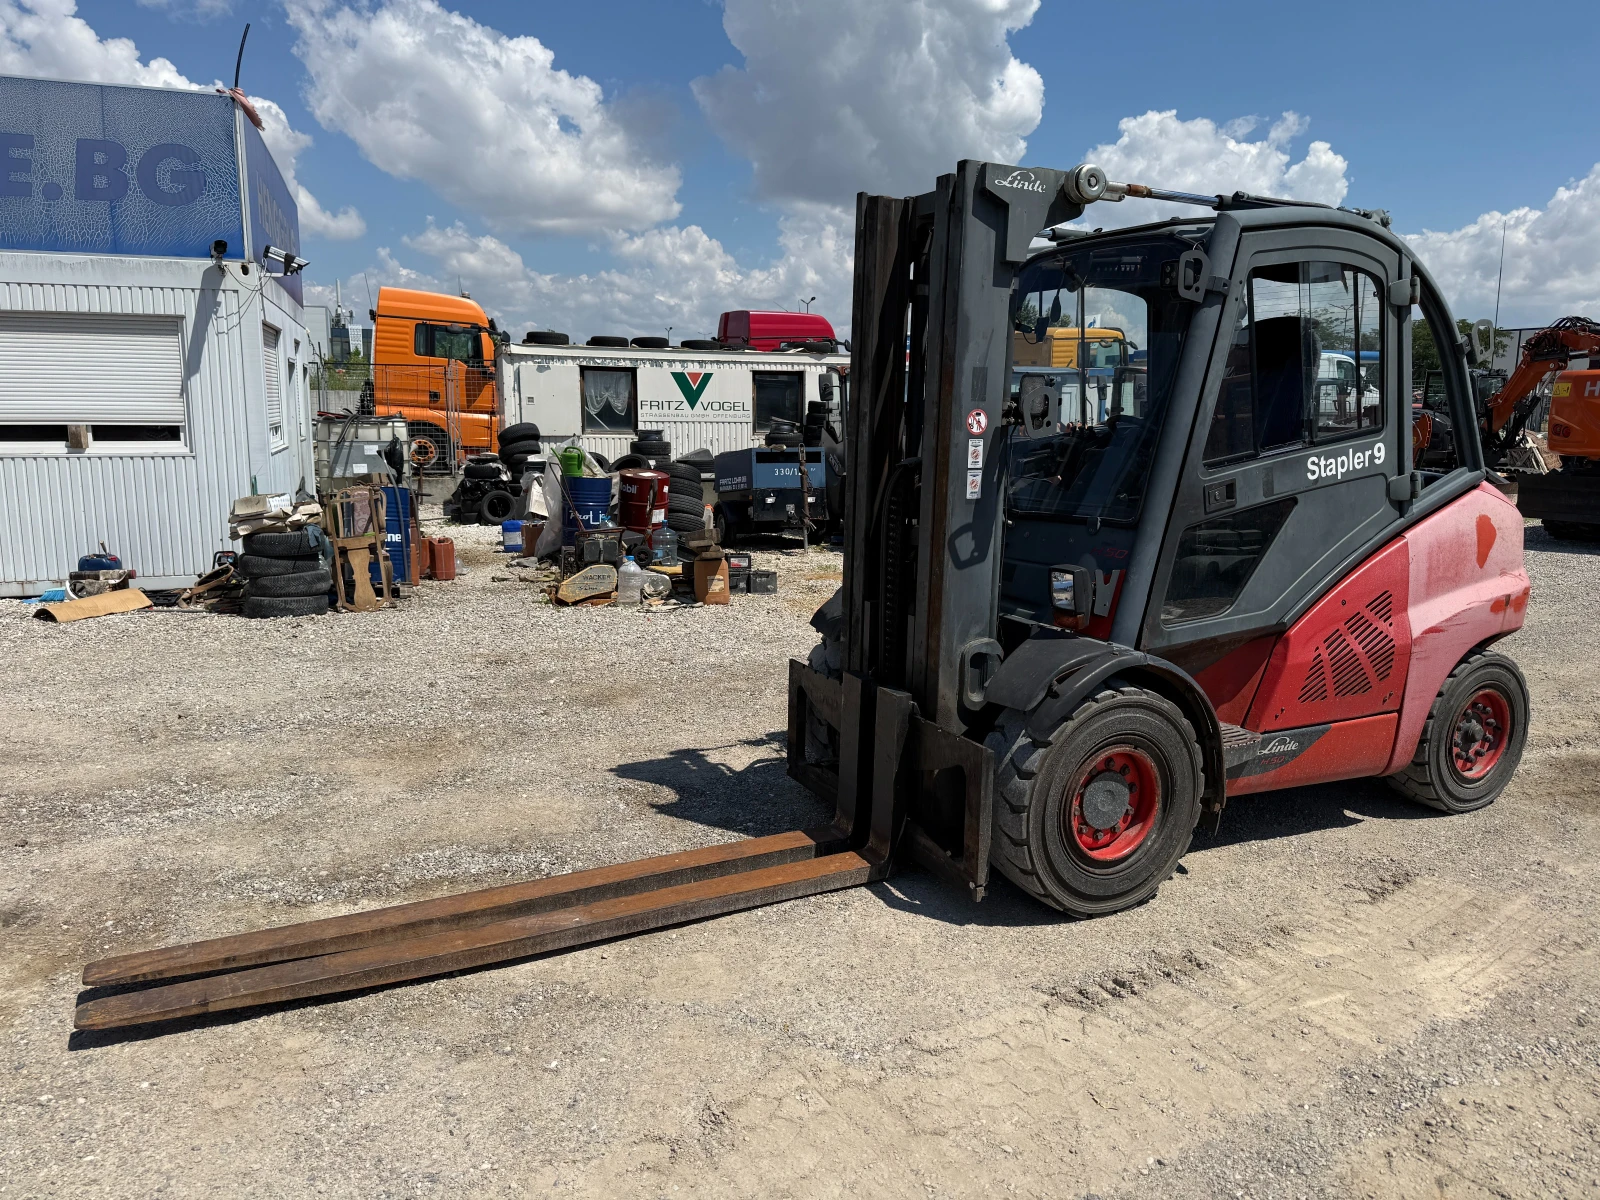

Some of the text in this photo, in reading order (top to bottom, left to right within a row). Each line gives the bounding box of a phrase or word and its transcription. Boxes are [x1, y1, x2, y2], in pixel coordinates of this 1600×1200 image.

[994, 170, 1047, 193] Linde
[640, 400, 750, 412] FRITZ VOGEL
[1306, 442, 1386, 480] Stapler 9
[774, 467, 802, 476] 330/1
[619, 483, 637, 494] obil
[1257, 736, 1299, 755] Linde
